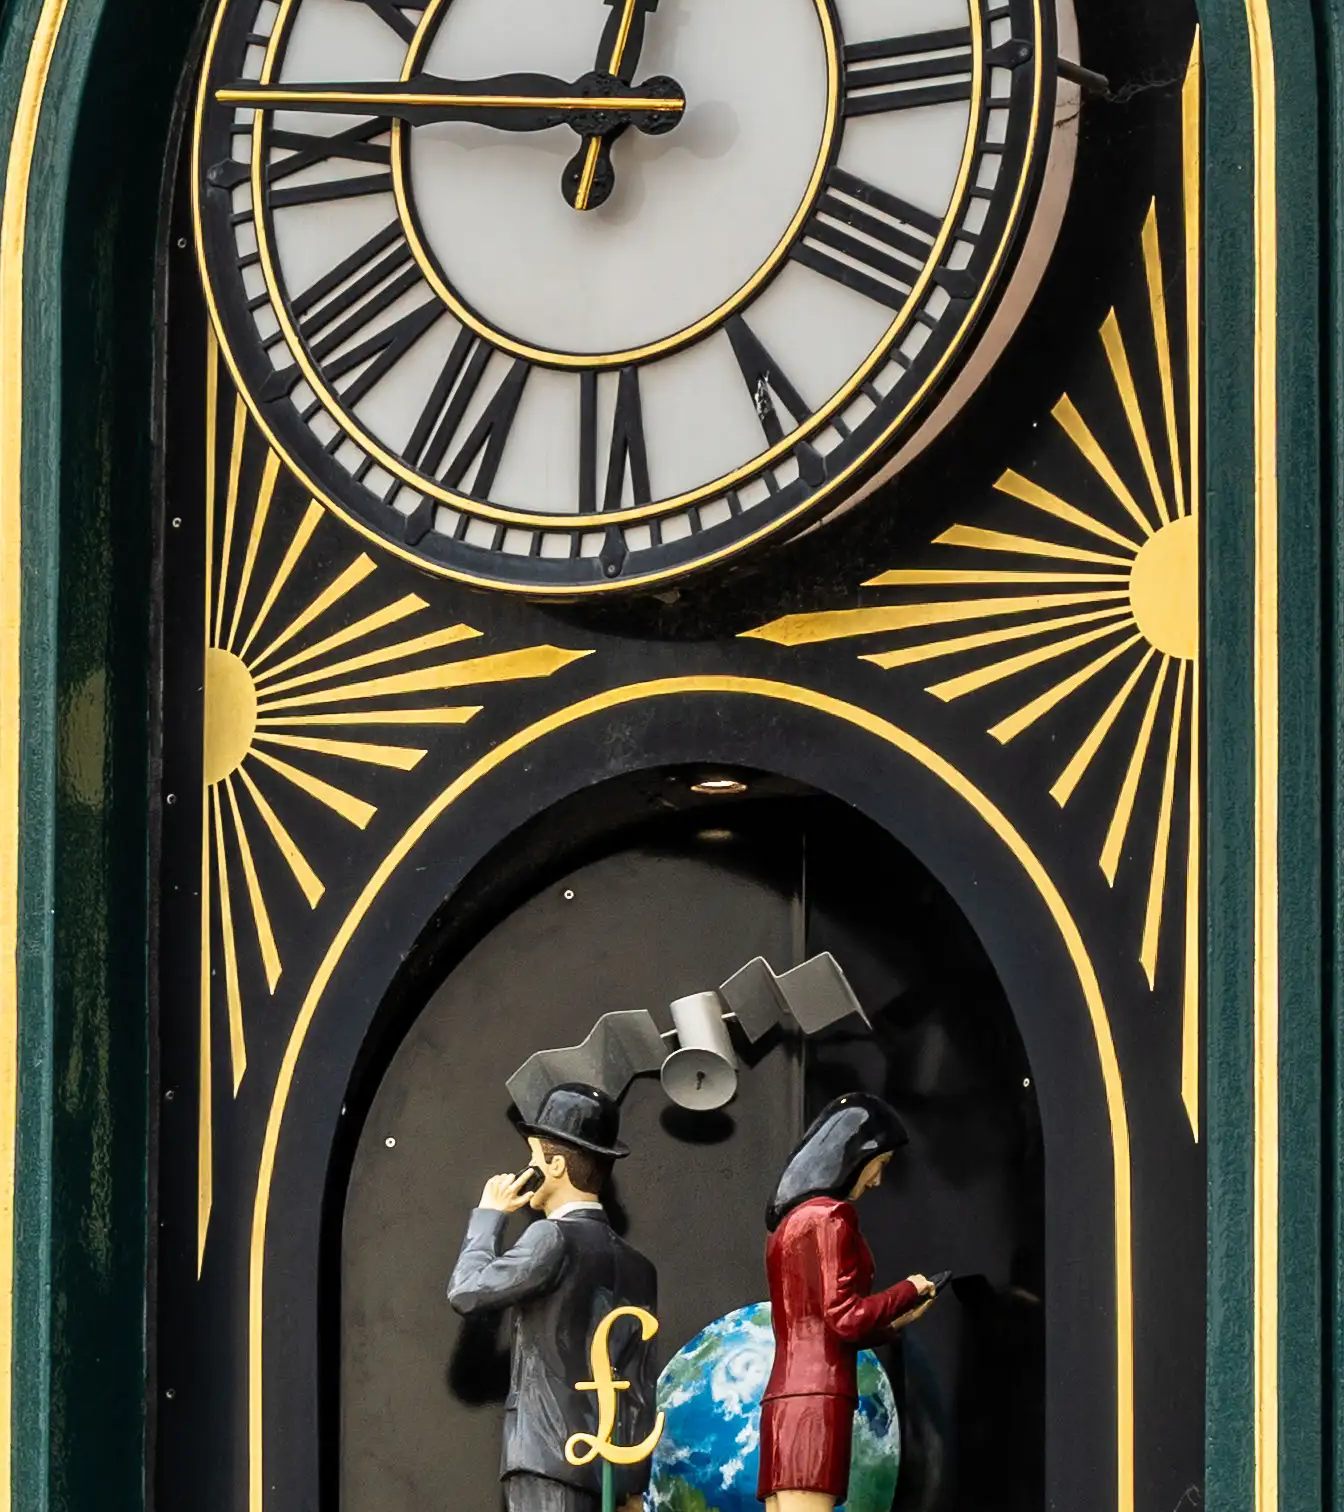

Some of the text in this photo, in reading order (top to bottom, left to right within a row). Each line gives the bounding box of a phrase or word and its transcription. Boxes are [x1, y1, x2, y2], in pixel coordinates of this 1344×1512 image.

[842, 26, 972, 116] III
[266, 117, 394, 207] IX
[792, 166, 942, 310] IIII
[295, 220, 445, 408] VIII
[726, 312, 814, 446] V
[404, 328, 531, 502] VII
[578, 364, 652, 514] VI
[565, 1305, 666, 1466] £
